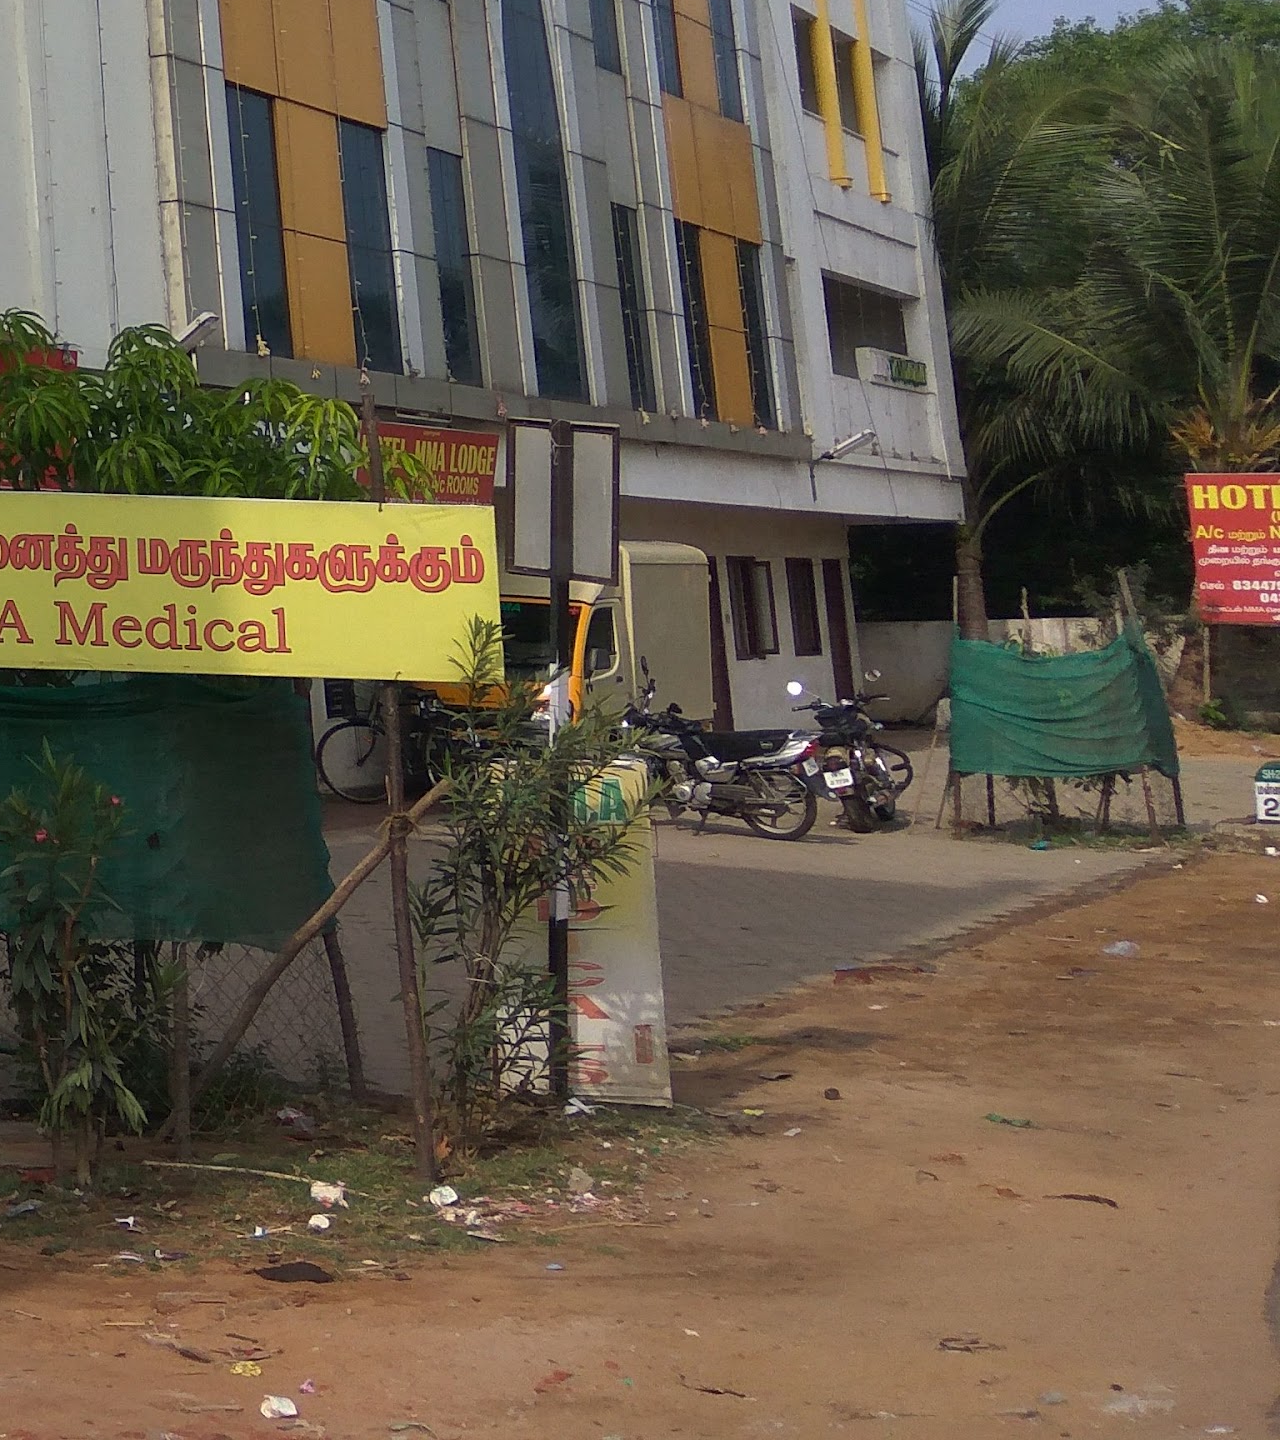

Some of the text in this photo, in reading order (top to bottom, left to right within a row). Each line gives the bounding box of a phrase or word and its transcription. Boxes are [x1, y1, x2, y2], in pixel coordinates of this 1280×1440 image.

[450, 444, 496, 475] LODGE
[447, 475, 480, 495] ROOMS
[1195, 524, 1225, 539] A/c
[138, 528, 484, 595] மருந்துகளுக்கும்
[54, 600, 292, 654] Medical
